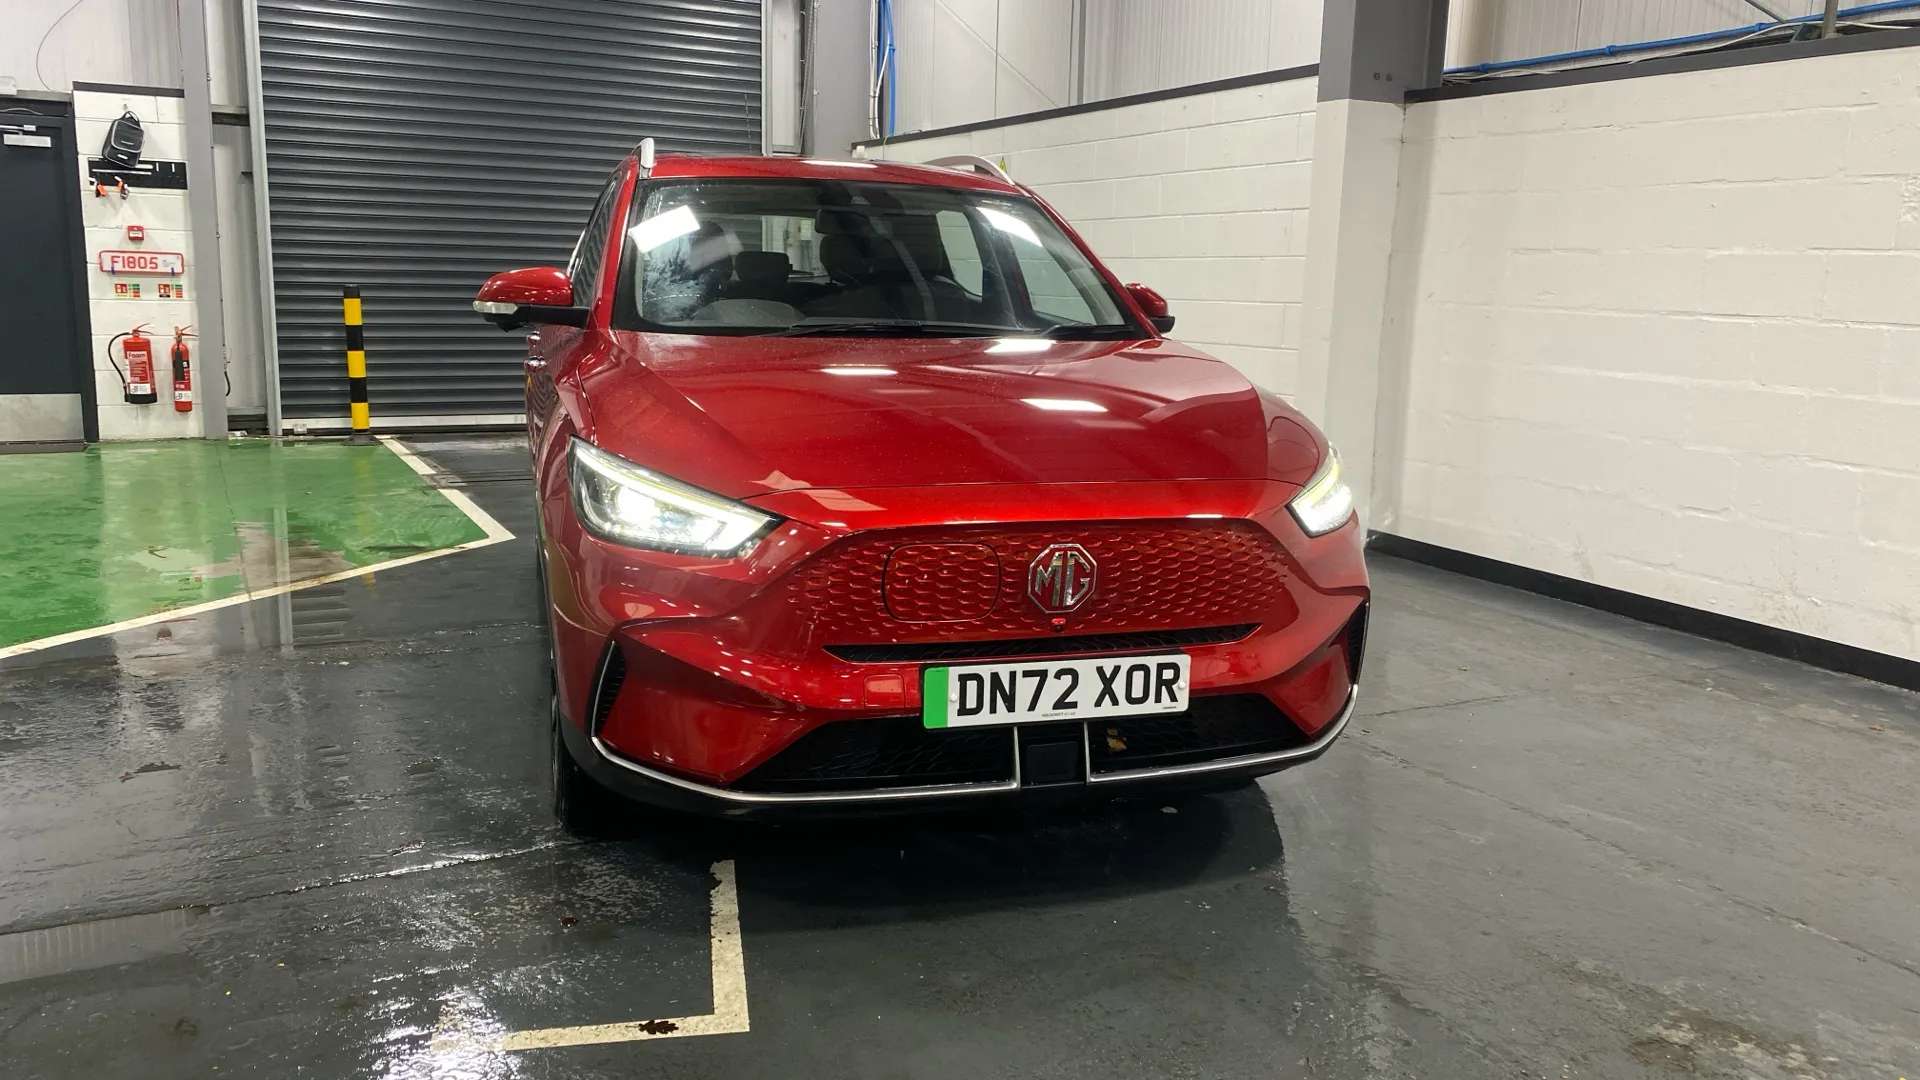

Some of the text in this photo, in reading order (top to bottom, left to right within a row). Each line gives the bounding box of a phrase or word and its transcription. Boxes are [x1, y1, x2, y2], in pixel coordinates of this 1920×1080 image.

[1035, 551, 1091, 607] MG
[957, 662, 1181, 716] DN72 XOR
